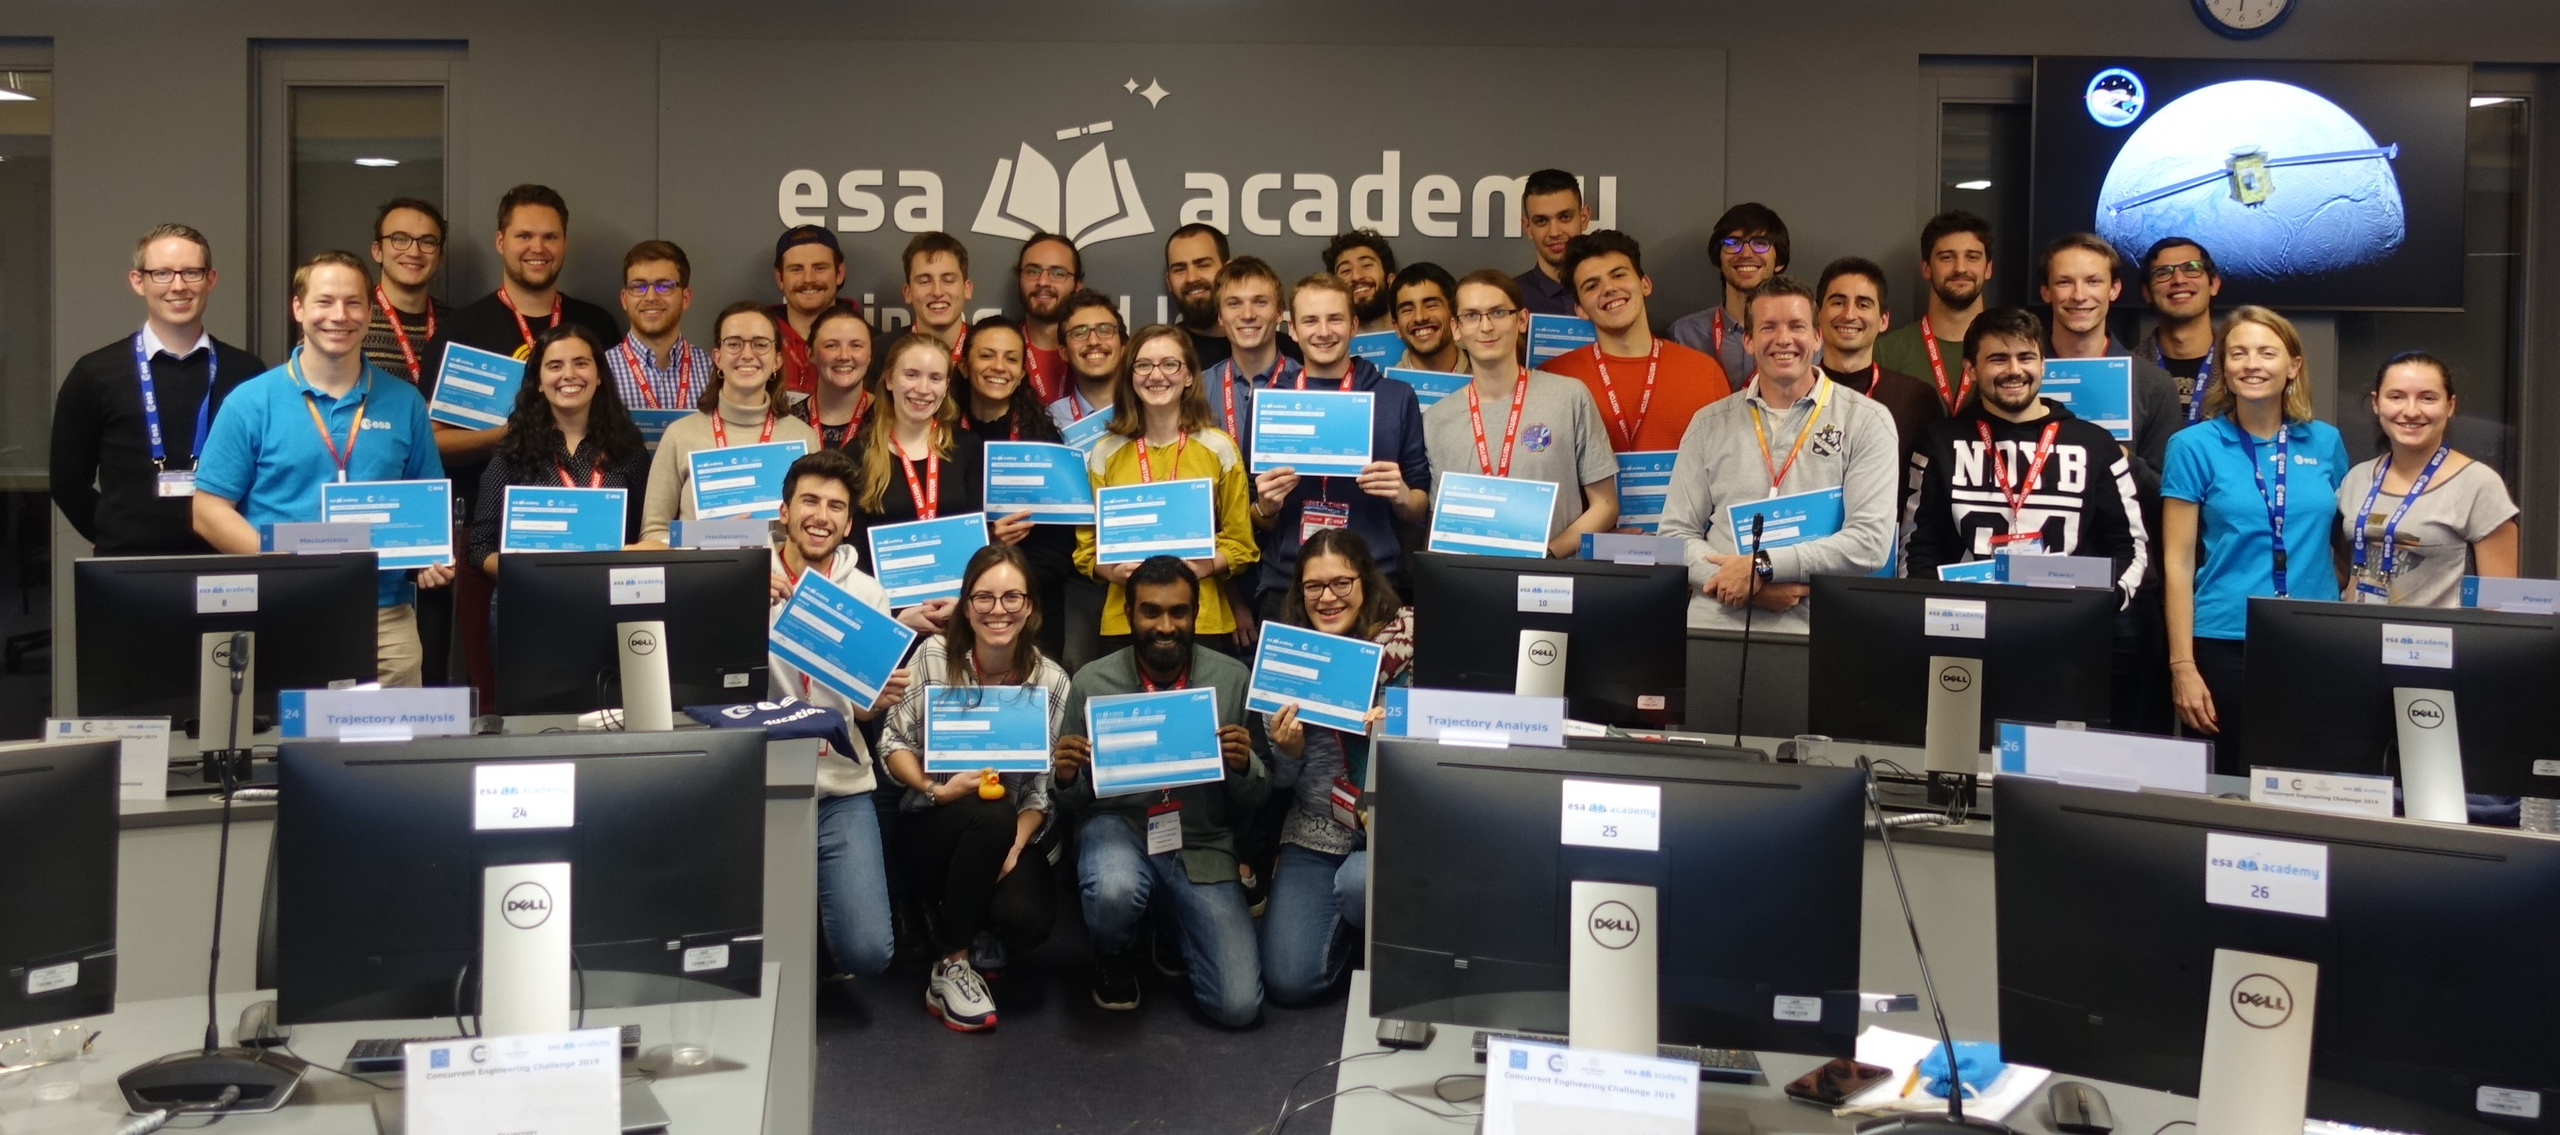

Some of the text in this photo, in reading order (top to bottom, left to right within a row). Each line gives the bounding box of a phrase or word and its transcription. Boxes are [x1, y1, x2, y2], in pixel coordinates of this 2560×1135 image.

[2225, 8, 2232, 17] 7
[2239, 13, 2245, 22] 6
[2256, 9, 2262, 18] 5
[778, 169, 944, 233] esa
[1027, 348, 1037, 370] VISITOR
[1928, 339, 1946, 388] VISITOR VISITOR
[1647, 362, 1656, 384] VISITOR
[1598, 362, 1620, 415] VISITOR VISITOR
[1640, 389, 1651, 414] VISITOR
[373, 421, 391, 430] esa
[1506, 410, 1518, 436] VISITOR
[1473, 411, 1483, 437] VISITOR
[1478, 441, 1488, 467] VISITOR
[1499, 442, 1511, 468] VISITOR
[2028, 430, 2053, 483] VISITOR VISITOR
[2303, 458, 2318, 466] esa
[2431, 453, 2443, 466] esa
[1140, 458, 1150, 483] VISITOR
[2276, 430, 2286, 506] esa esa esa
[929, 480, 937, 504] VISITOR
[2411, 480, 2423, 494] esa
[912, 483, 924, 509] VISITOR
[2364, 496, 2374, 510] esa
[2391, 509, 2402, 523] esa
[1544, 587, 1570, 596] academy
[1955, 612, 1984, 620] academy
[1950, 624, 1960, 632] 11
[2416, 638, 2449, 648] academy
[1532, 649, 1554, 657] DELL
[2409, 651, 2420, 660] 12
[1944, 675, 1967, 683] DELL
[284, 709, 455, 726] 24 Trajectory Analysis
[1388, 706, 1549, 733] 25 Trajectory Analysis
[2412, 709, 2441, 719] DELL
[2003, 740, 2019, 752] 26
[480, 786, 568, 796] esa academy
[512, 807, 528, 819] 24
[1568, 803, 1656, 818] esa academy
[1602, 825, 1618, 838] 25
[2211, 857, 2319, 880] esa academy
[2250, 885, 2269, 899] 26
[508, 899, 547, 911] DELL
[1594, 918, 1634, 932] DELL
[2237, 991, 2285, 1011] DELL
[578, 1040, 610, 1049] academy
[426, 1058, 600, 1080] Concurrent Engineering Challenge 2019
[1624, 1068, 1688, 1084] esa academy
[1504, 1071, 1676, 1100] Concurrent Engineering Challenge 2019
